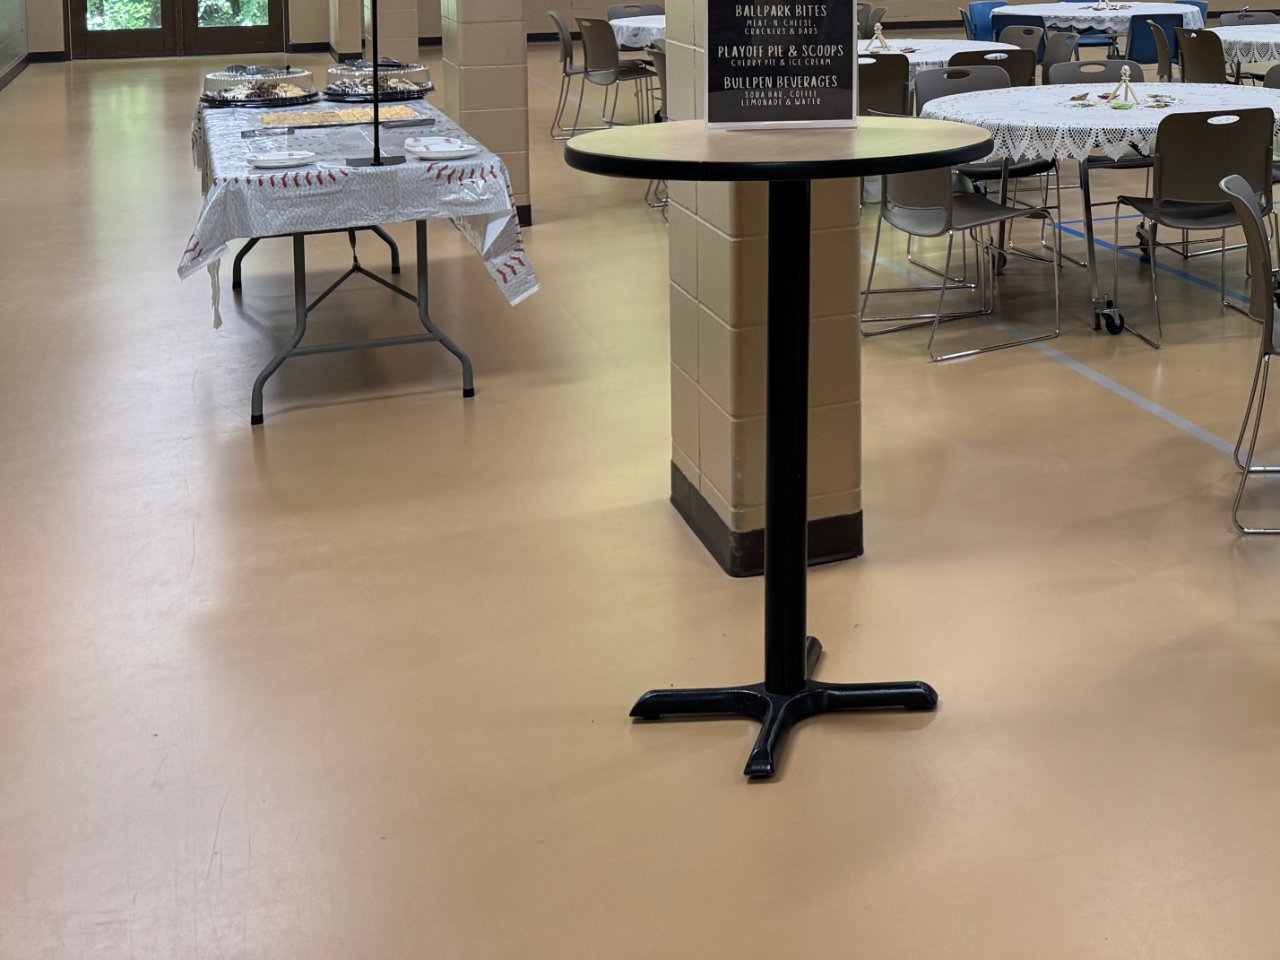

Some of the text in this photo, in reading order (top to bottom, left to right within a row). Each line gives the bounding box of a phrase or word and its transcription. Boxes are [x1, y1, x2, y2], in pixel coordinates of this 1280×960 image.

[735, 4, 827, 17] BALLPARK BITES
[744, 27, 818, 35] CRACKERS & BARS
[718, 44, 844, 58] PLAYOFF PIE & SCOOPS
[731, 59, 761, 67] CHERRY
[790, 58, 801, 66] ICE
[805, 58, 831, 66] CREAM
[724, 75, 838, 89] BULLPEN BEVERAGES
[744, 91, 765, 99] SODA
[741, 98, 782, 107] LEMONADE
[785, 98, 791, 106] &
